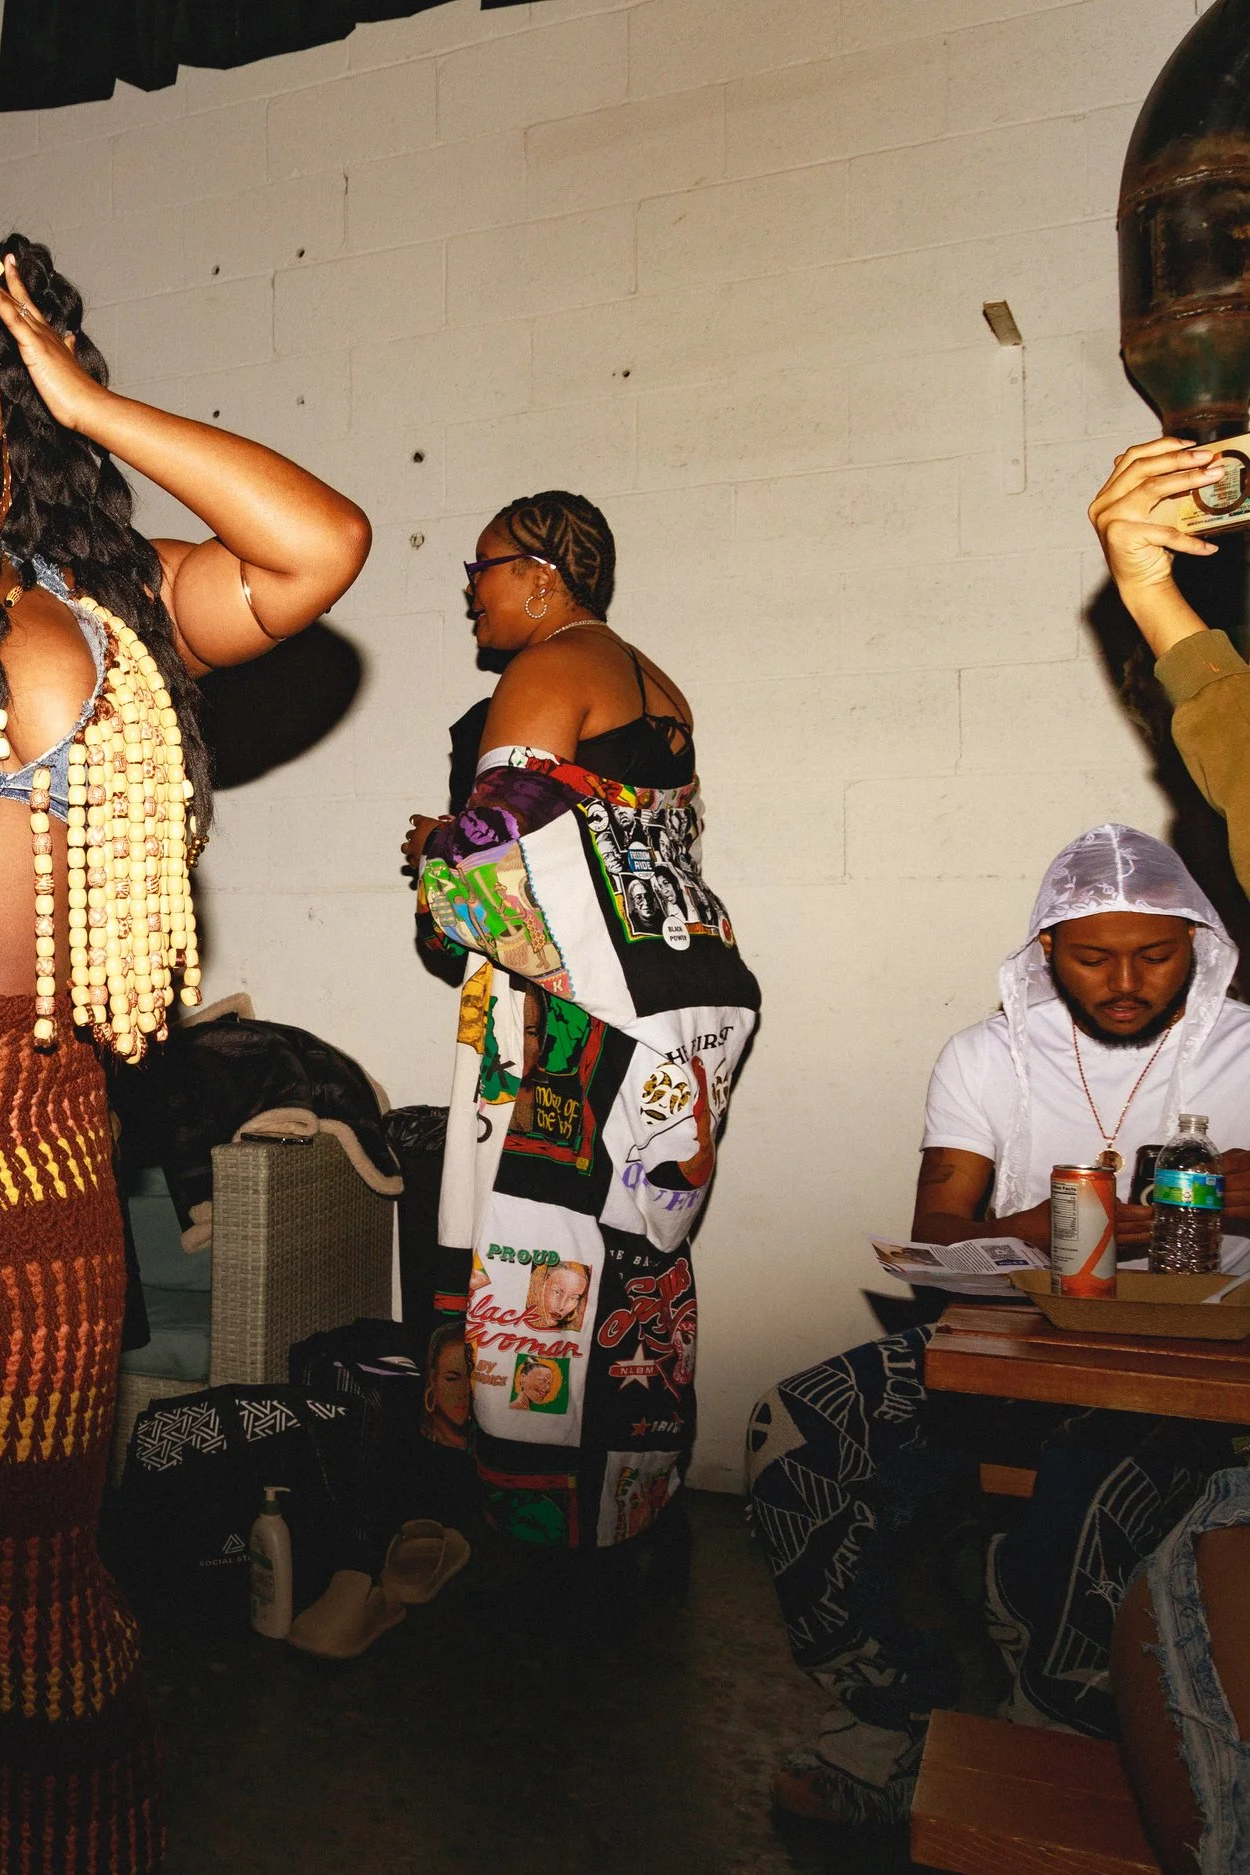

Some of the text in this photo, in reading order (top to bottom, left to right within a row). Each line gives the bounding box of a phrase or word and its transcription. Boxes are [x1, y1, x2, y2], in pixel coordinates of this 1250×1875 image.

[634, 861, 653, 870] RIDE
[487, 1243, 561, 1266] PROUD
[475, 1359, 498, 1374] BY
[620, 1366, 654, 1375] NLBM
[199, 1557, 234, 1567] SOCIAL
